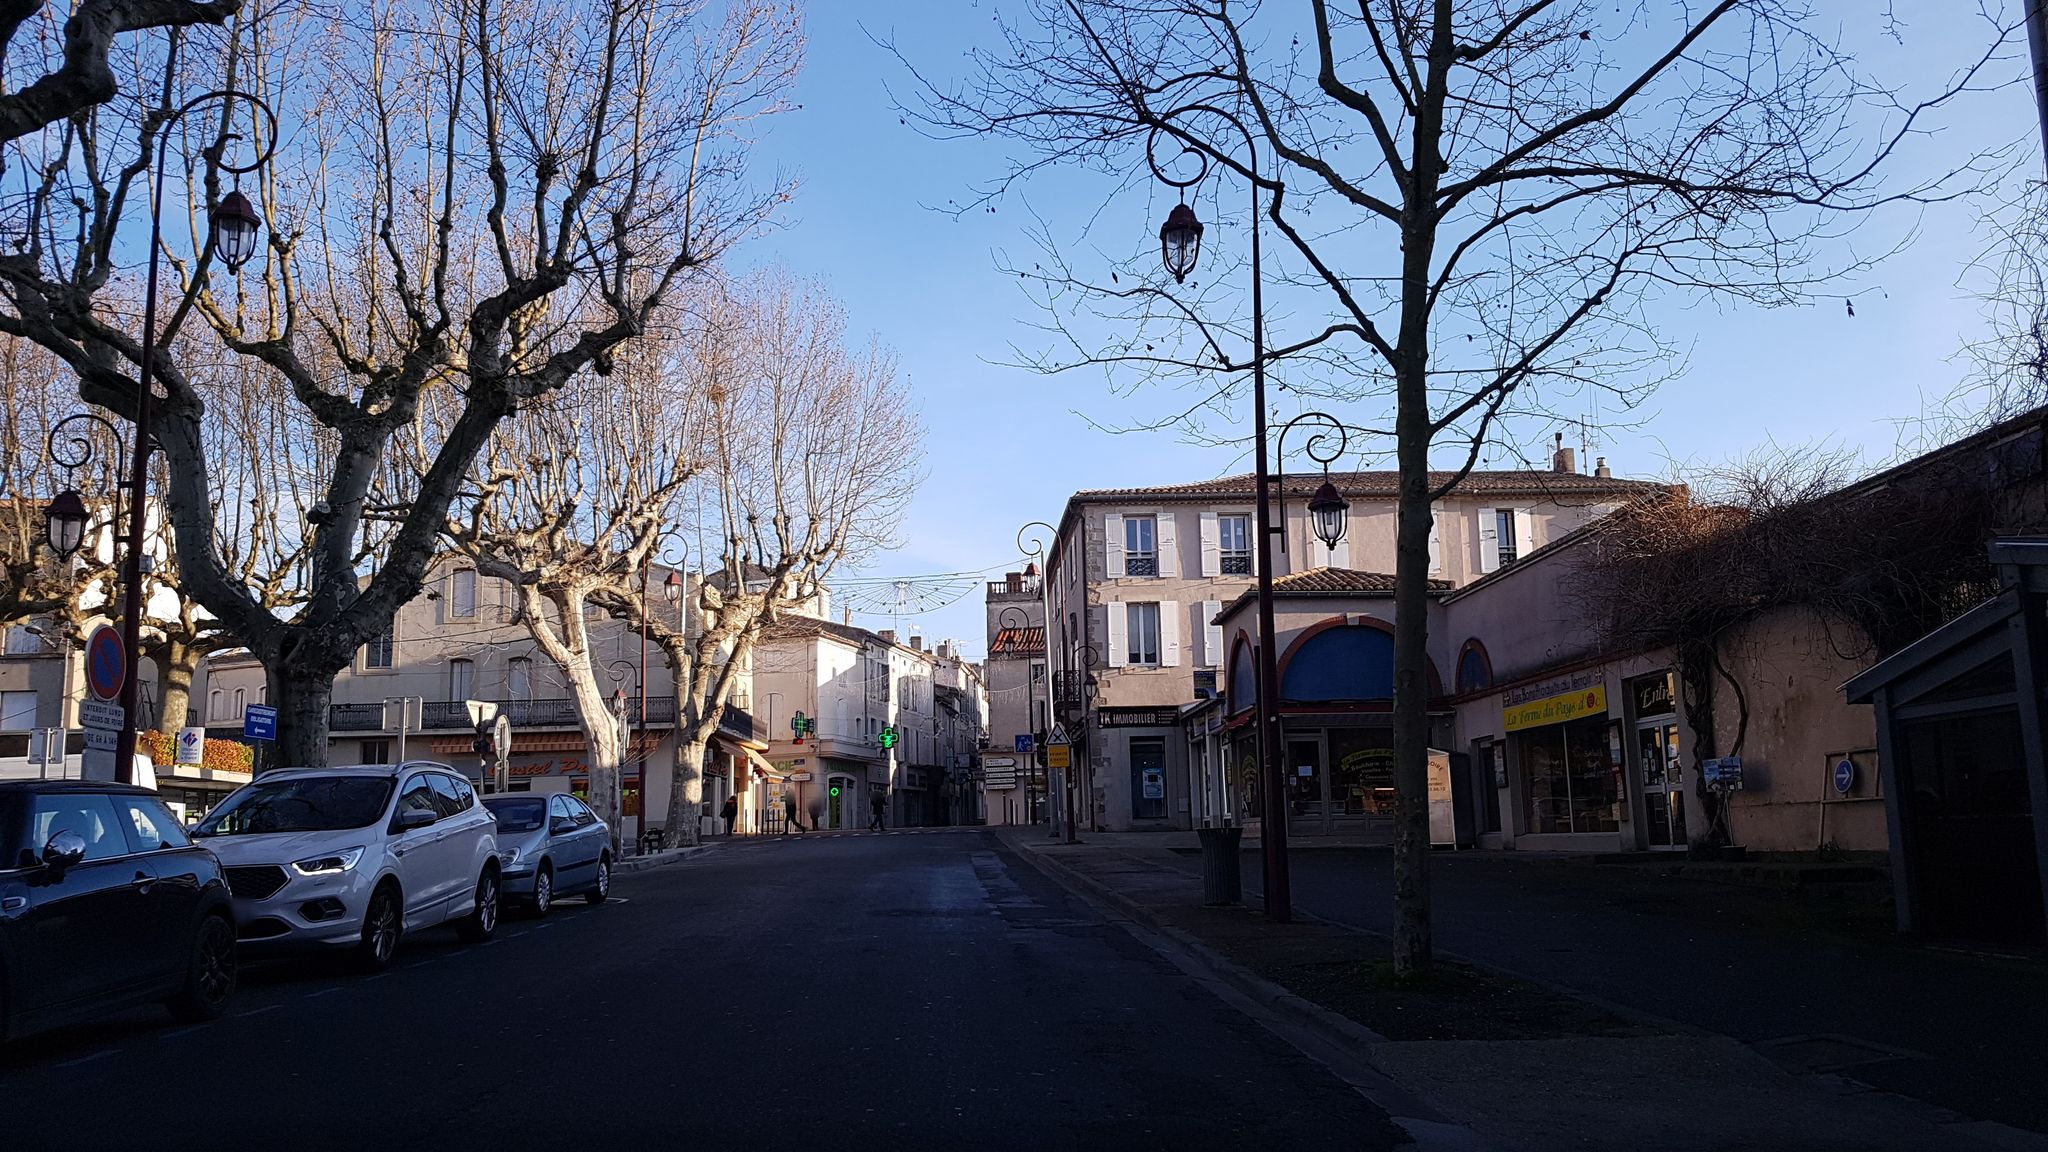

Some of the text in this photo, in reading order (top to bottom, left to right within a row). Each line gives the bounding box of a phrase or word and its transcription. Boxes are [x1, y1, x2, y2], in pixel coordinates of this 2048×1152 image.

[1099, 711, 1111, 724] TK
[1112, 713, 1156, 724] IMMOBILIER
[1507, 713, 1516, 726] La
[1518, 706, 1541, 724] Ferme
[771, 760, 795, 771] ACIE
